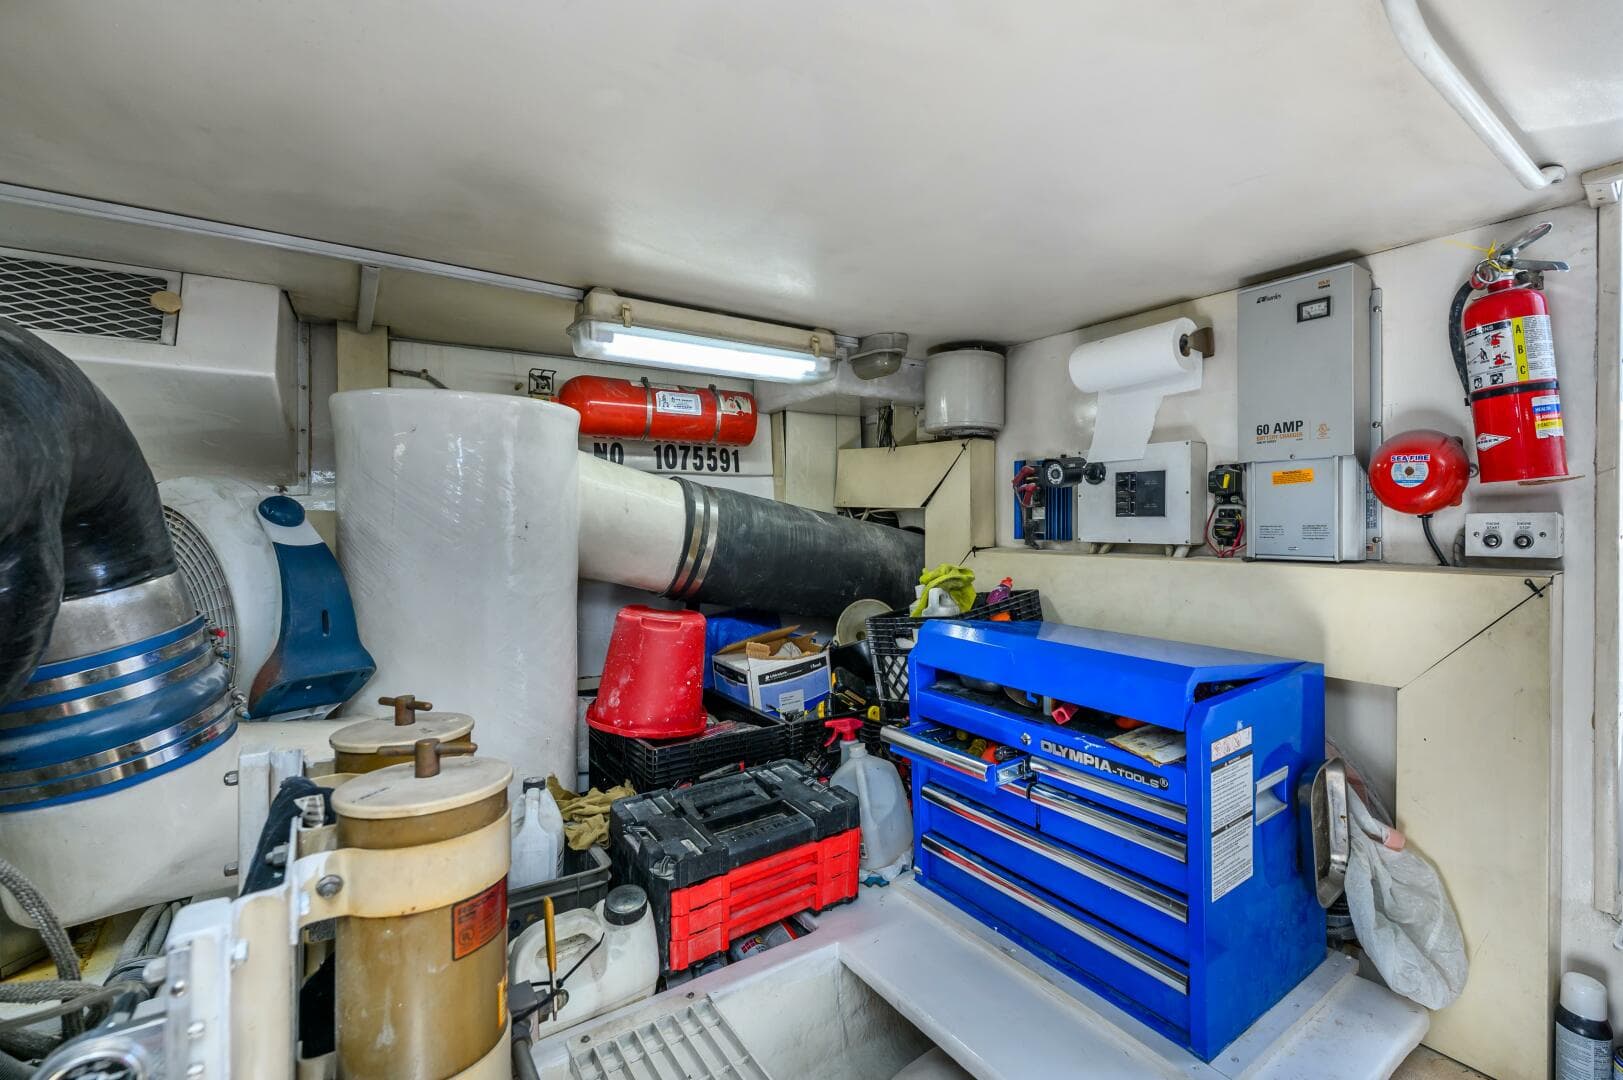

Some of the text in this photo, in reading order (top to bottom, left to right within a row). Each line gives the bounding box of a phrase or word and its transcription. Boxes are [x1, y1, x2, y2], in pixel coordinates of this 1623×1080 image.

[1515, 324, 1522, 334] A
[1517, 345, 1525, 354] B
[1519, 365, 1527, 375] C
[1256, 420, 1304, 436] 60 AMP
[653, 444, 740, 473] 1075591
